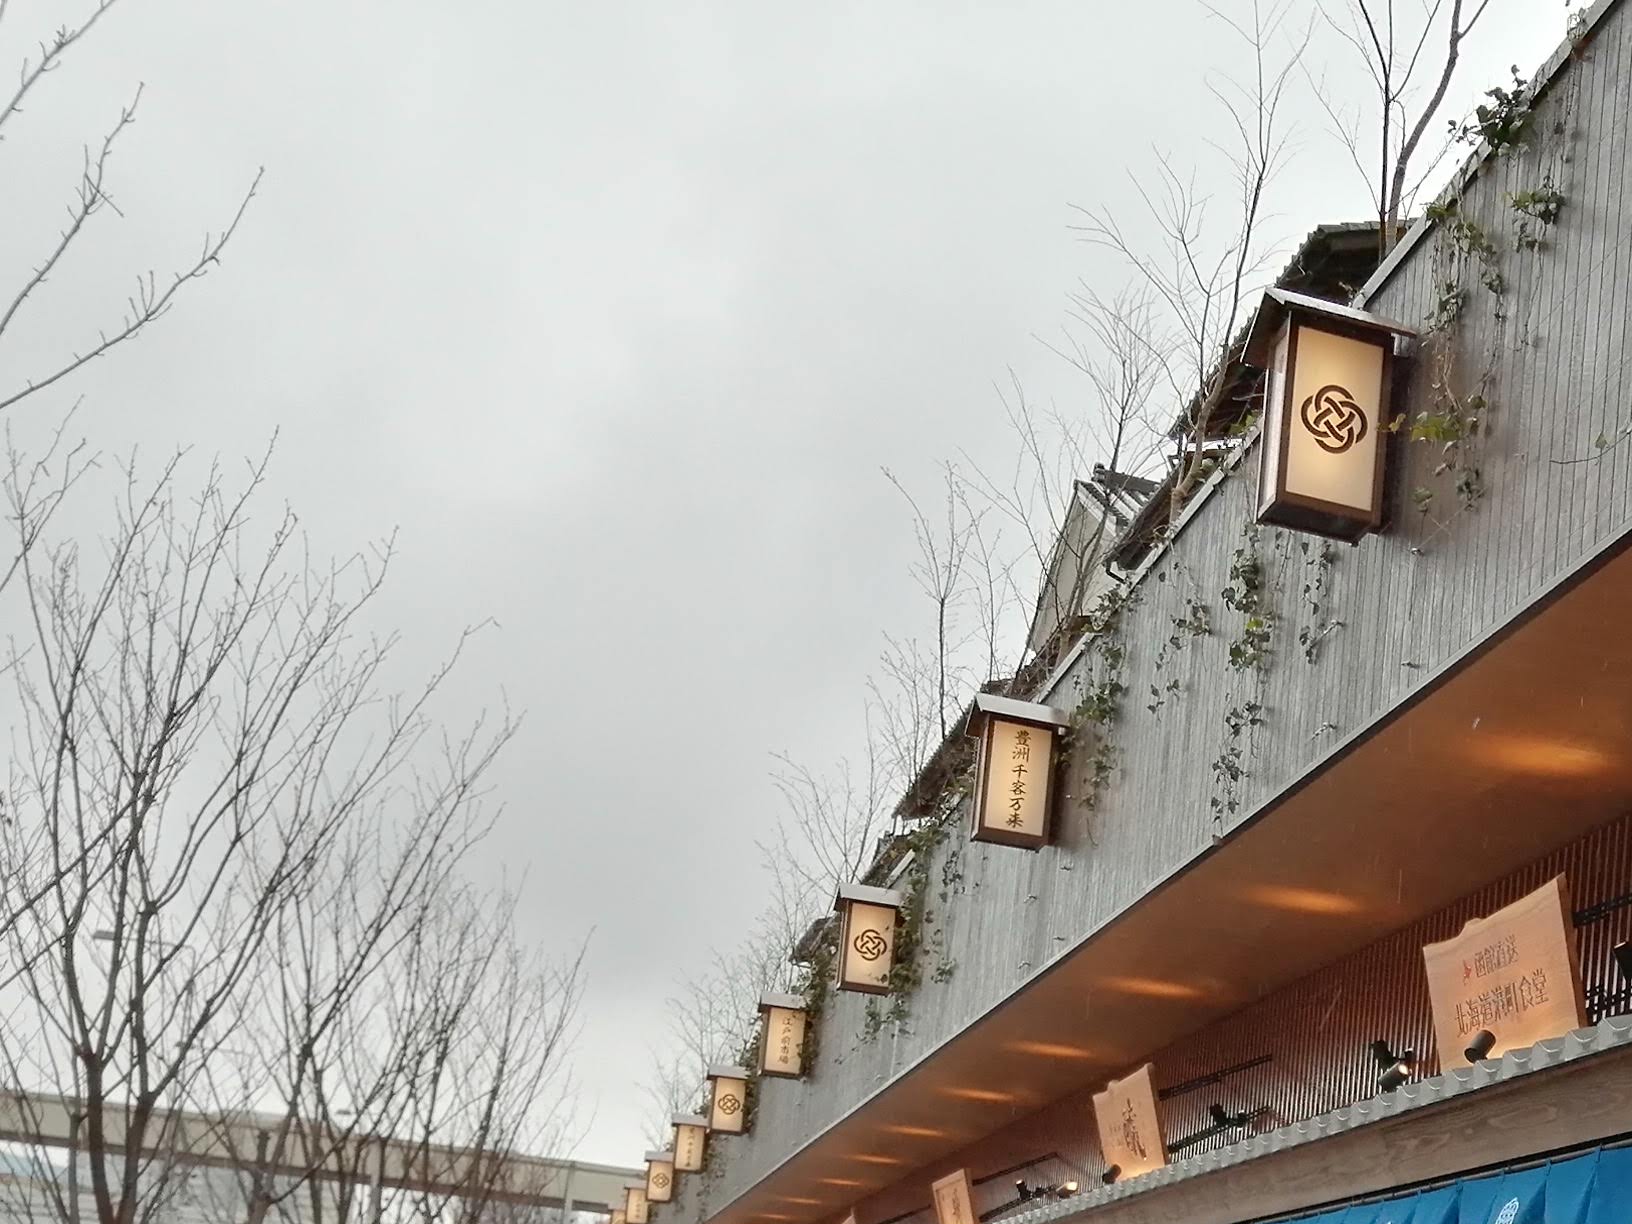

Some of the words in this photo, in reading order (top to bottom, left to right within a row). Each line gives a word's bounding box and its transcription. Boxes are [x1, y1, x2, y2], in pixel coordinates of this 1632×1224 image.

[1005, 729, 1031, 828] 豊洲千客万来
